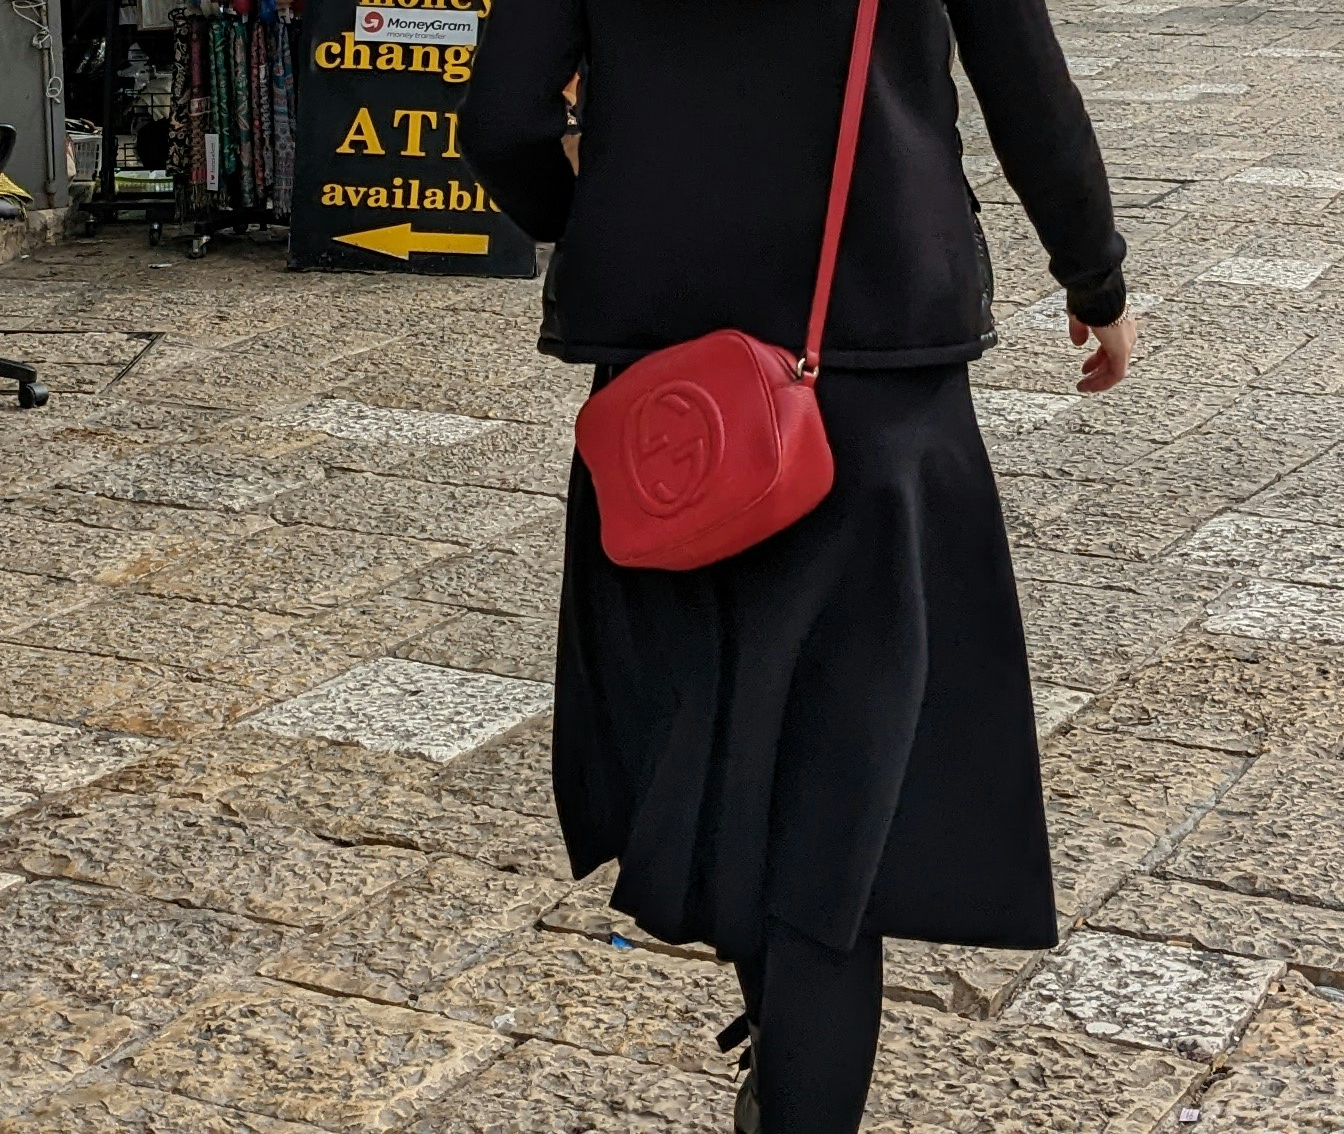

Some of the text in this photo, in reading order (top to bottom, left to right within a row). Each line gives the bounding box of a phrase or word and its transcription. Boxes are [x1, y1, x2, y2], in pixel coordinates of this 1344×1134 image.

[386, 17, 471, 33] MoneyGram
[386, 32, 447, 40] money transfer
[314, 31, 476, 83] chang
